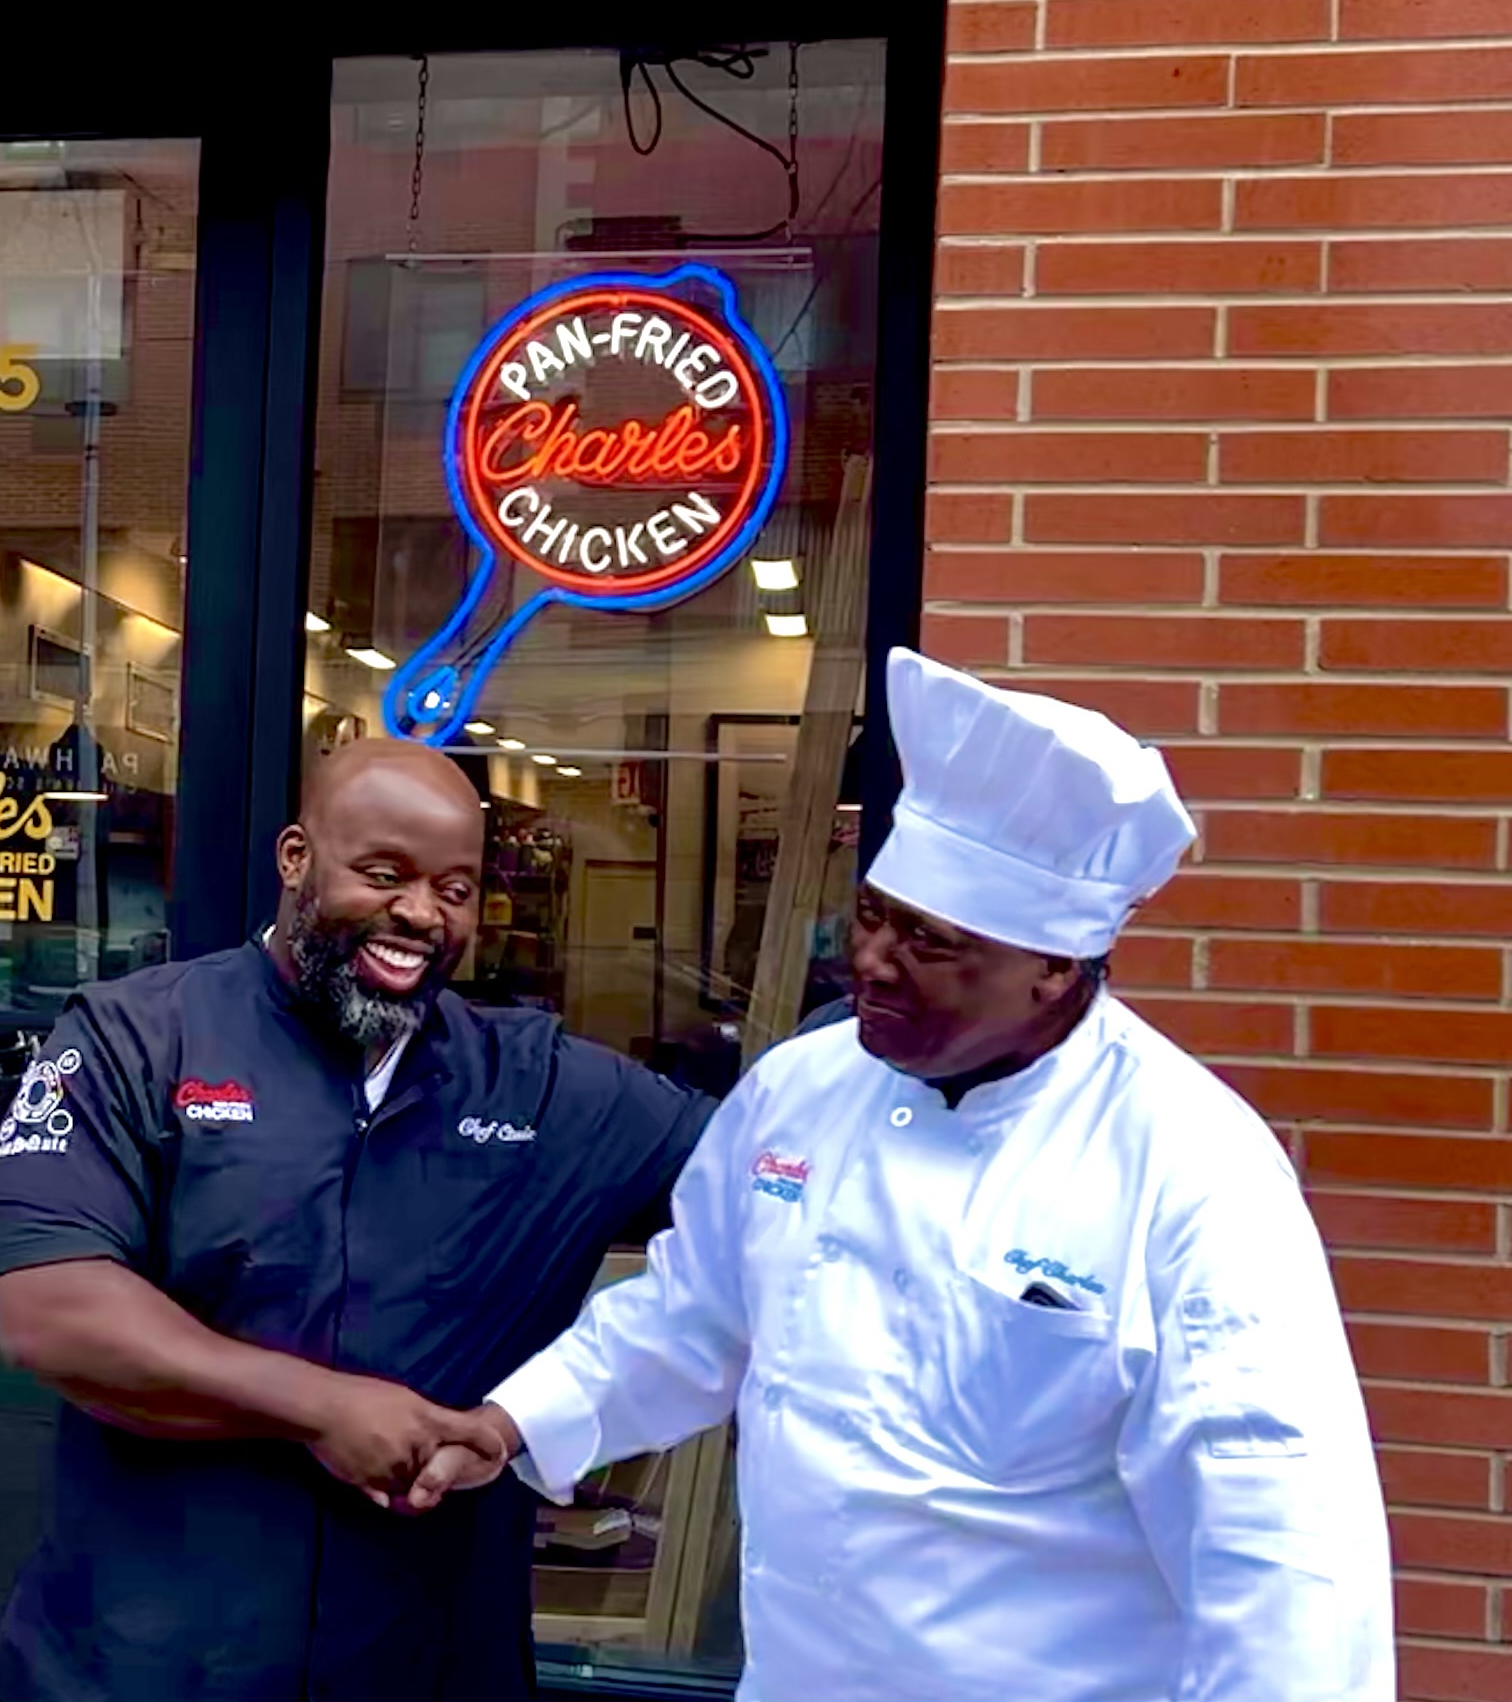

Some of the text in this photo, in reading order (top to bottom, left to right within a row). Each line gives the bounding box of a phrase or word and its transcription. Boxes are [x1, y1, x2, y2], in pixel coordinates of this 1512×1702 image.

[498, 312, 740, 409] PAN-FRIED
[480, 401, 742, 481] Charles
[497, 486, 722, 572] CHICKEN
